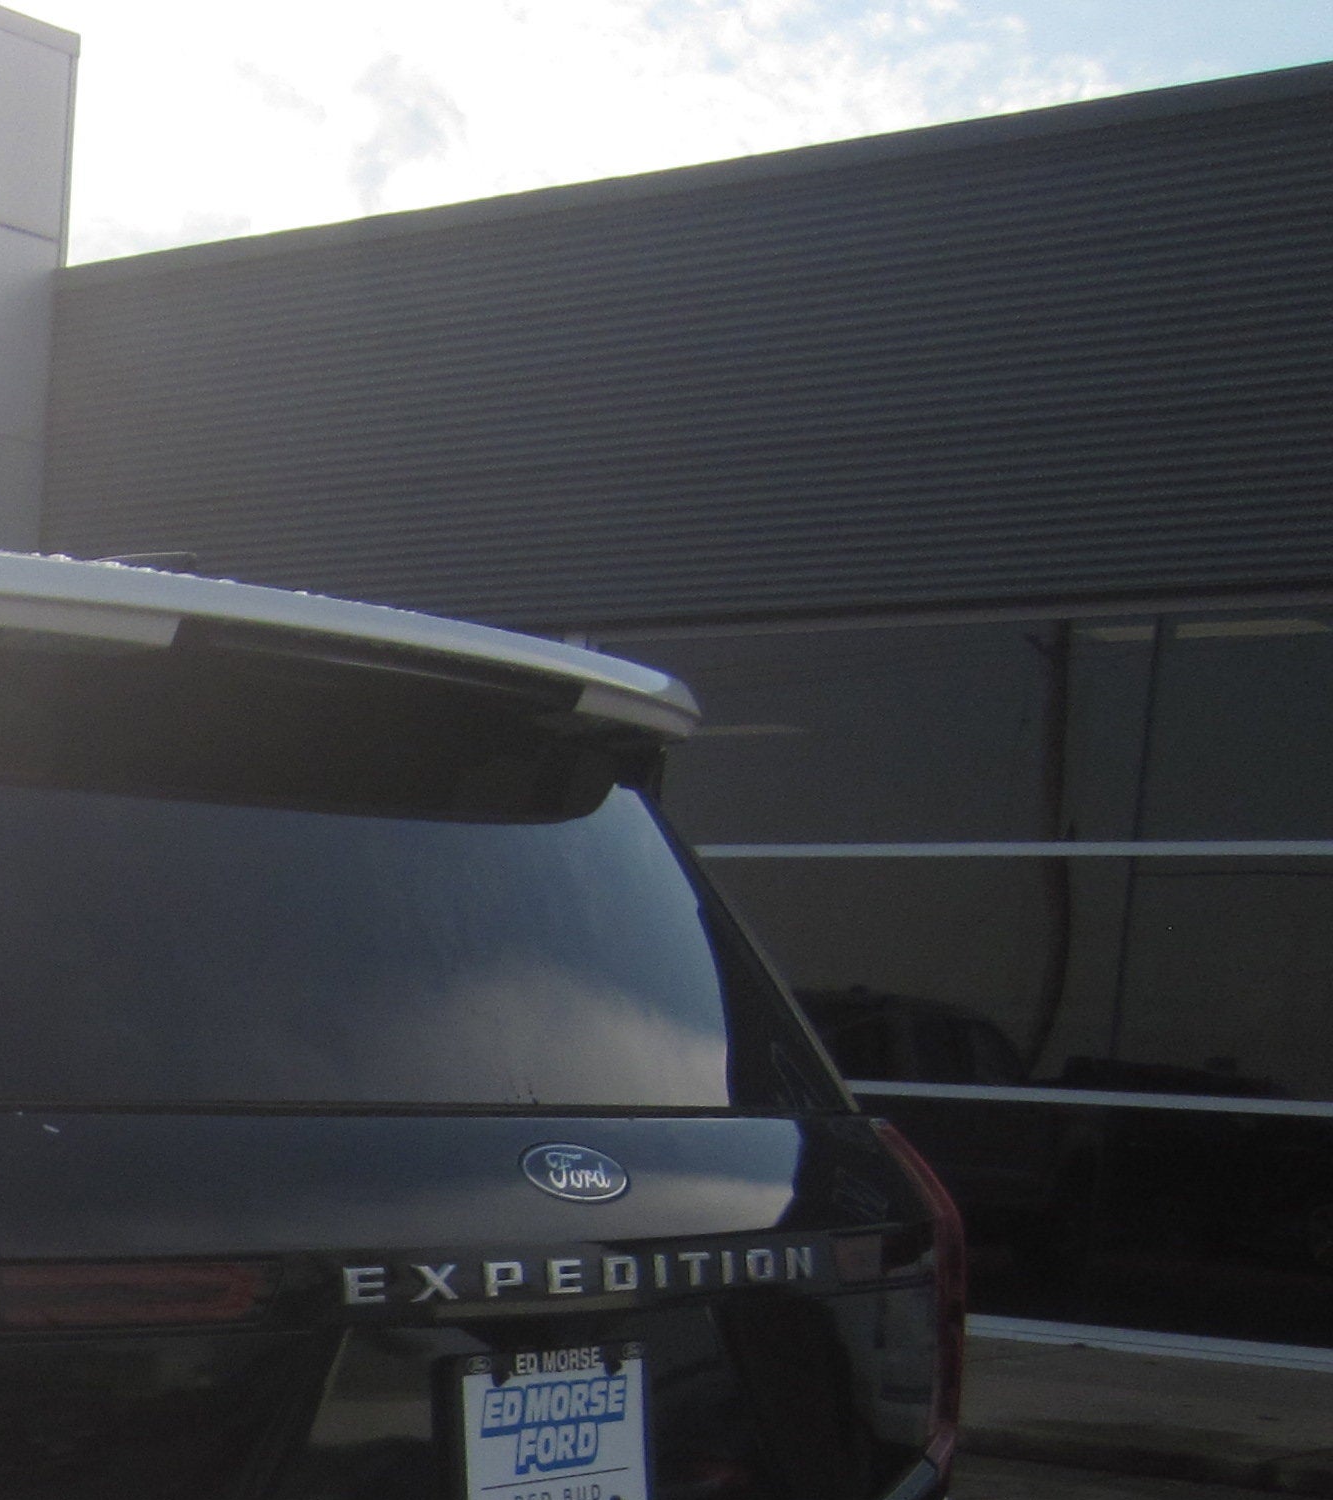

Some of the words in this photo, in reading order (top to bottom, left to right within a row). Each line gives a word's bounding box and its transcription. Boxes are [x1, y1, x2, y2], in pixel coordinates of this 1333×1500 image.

[544, 1151, 612, 1190] Ford
[342, 1246, 814, 1305] EXPEDITION
[516, 1353, 537, 1374] ED
[542, 1347, 600, 1372] MORSE
[481, 1387, 524, 1438] ED
[523, 1375, 627, 1425] MORSE
[515, 1421, 598, 1475] FORD
